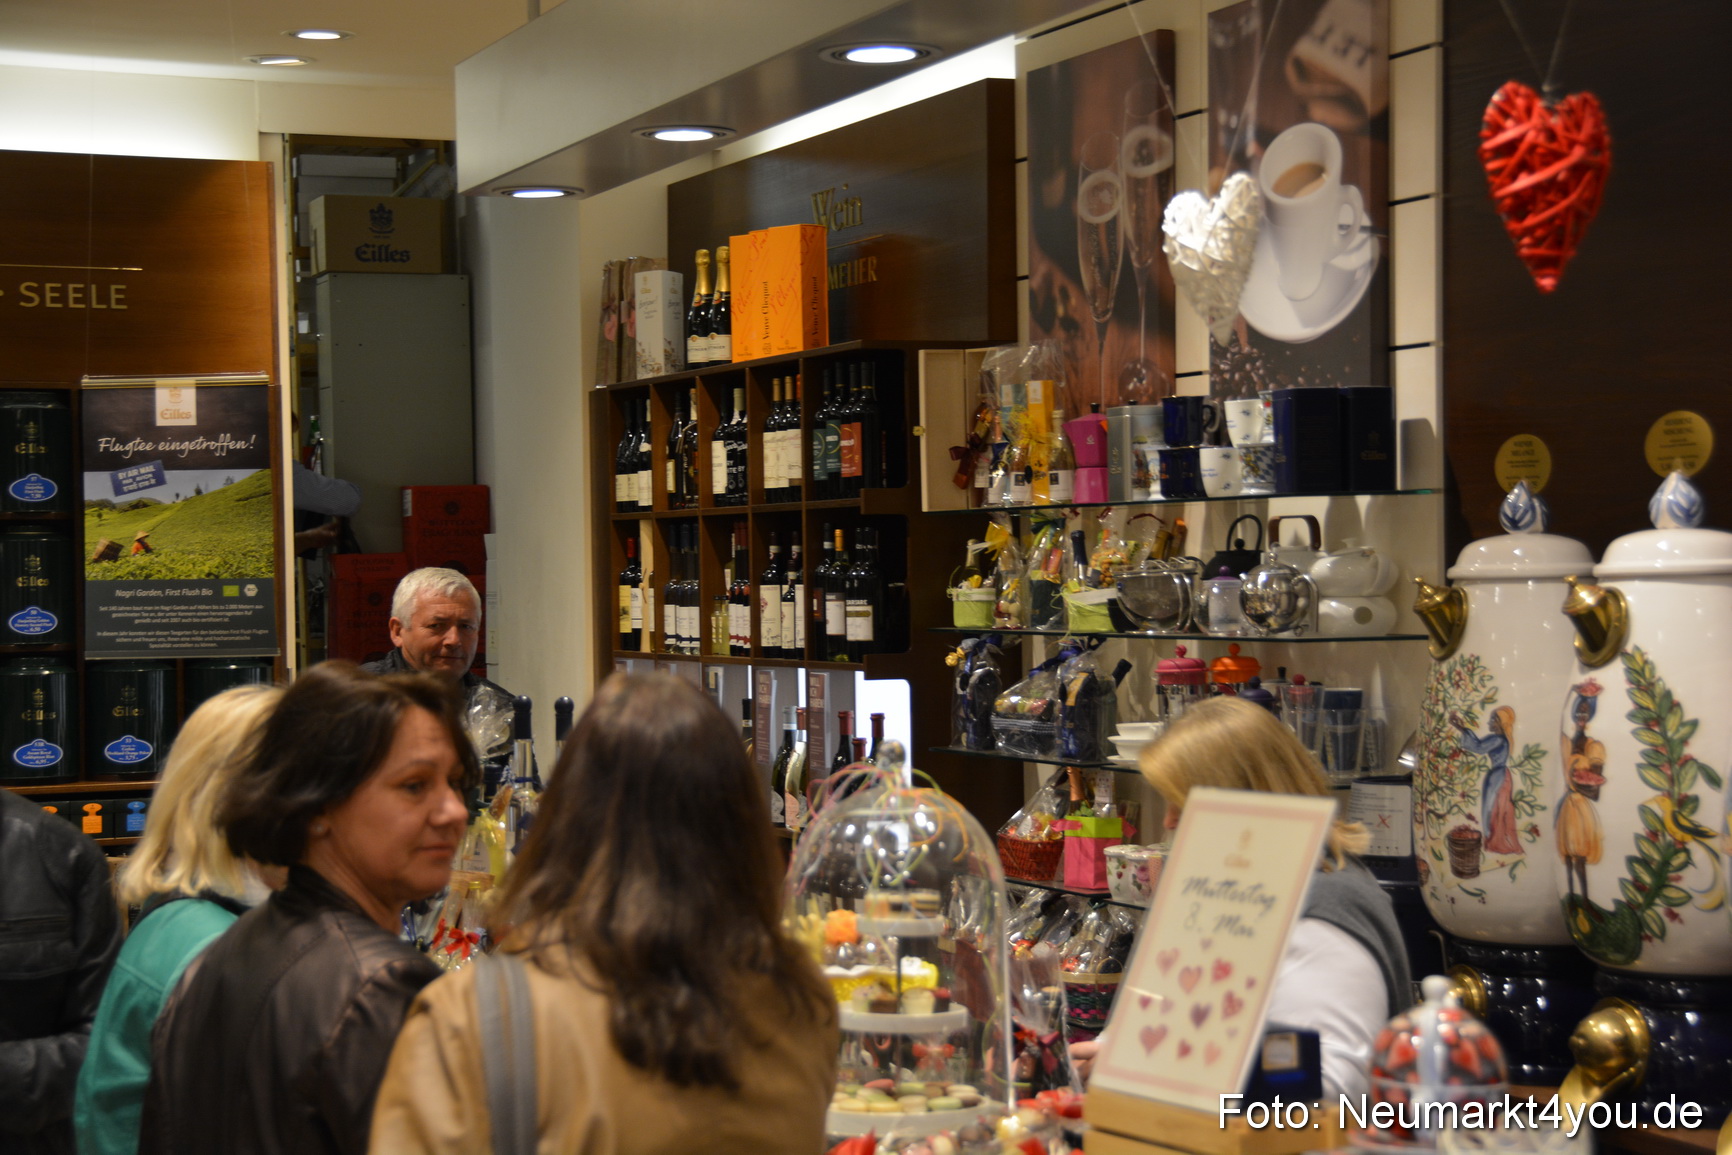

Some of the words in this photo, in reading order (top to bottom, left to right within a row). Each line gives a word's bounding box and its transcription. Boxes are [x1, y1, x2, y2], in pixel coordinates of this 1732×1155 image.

[811, 183, 863, 234] Wein
[354, 243, 412, 264] Eilles
[18, 281, 128, 310] SEELE
[160, 408, 192, 420] Eilles
[98, 437, 157, 459] Flugtee
[158, 433, 257, 458] eingetroffen!
[1182, 875, 1278, 919] Muttertag
[1213, 913, 1256, 938] Mai
